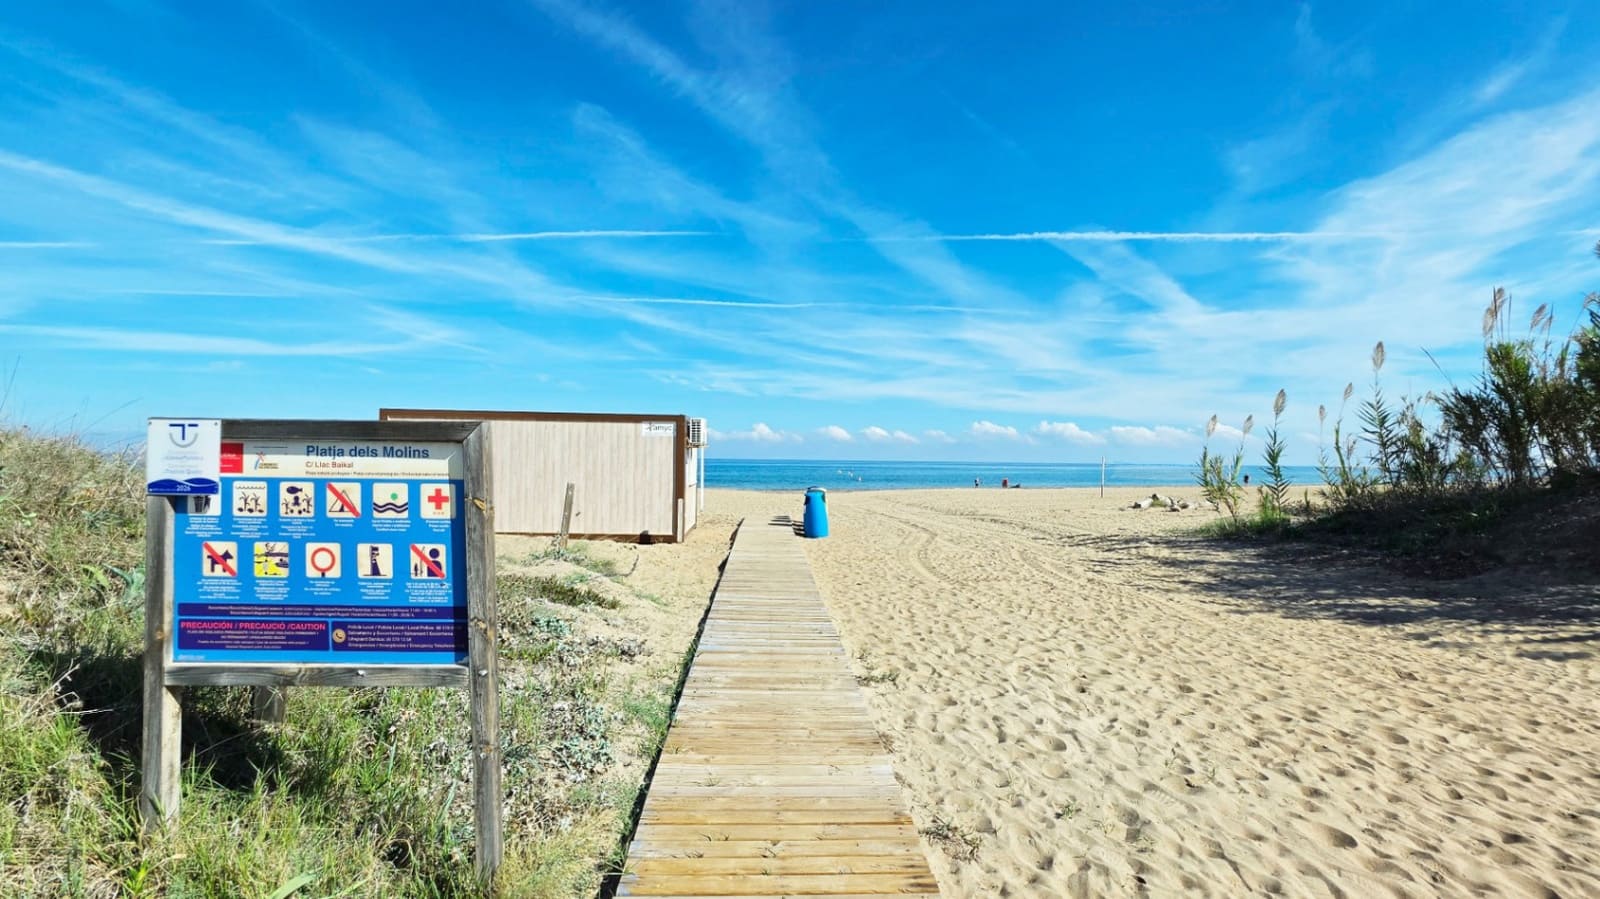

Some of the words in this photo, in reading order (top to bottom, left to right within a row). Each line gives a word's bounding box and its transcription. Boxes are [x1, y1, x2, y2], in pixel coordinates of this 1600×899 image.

[306, 445, 345, 459] Platja
[349, 445, 378, 458] dels
[382, 446, 430, 459] Molins
[315, 461, 330, 469] Llac
[180, 621, 233, 629] PRECAUCIÓN
[239, 621, 286, 630] PRECAUCIÓ
